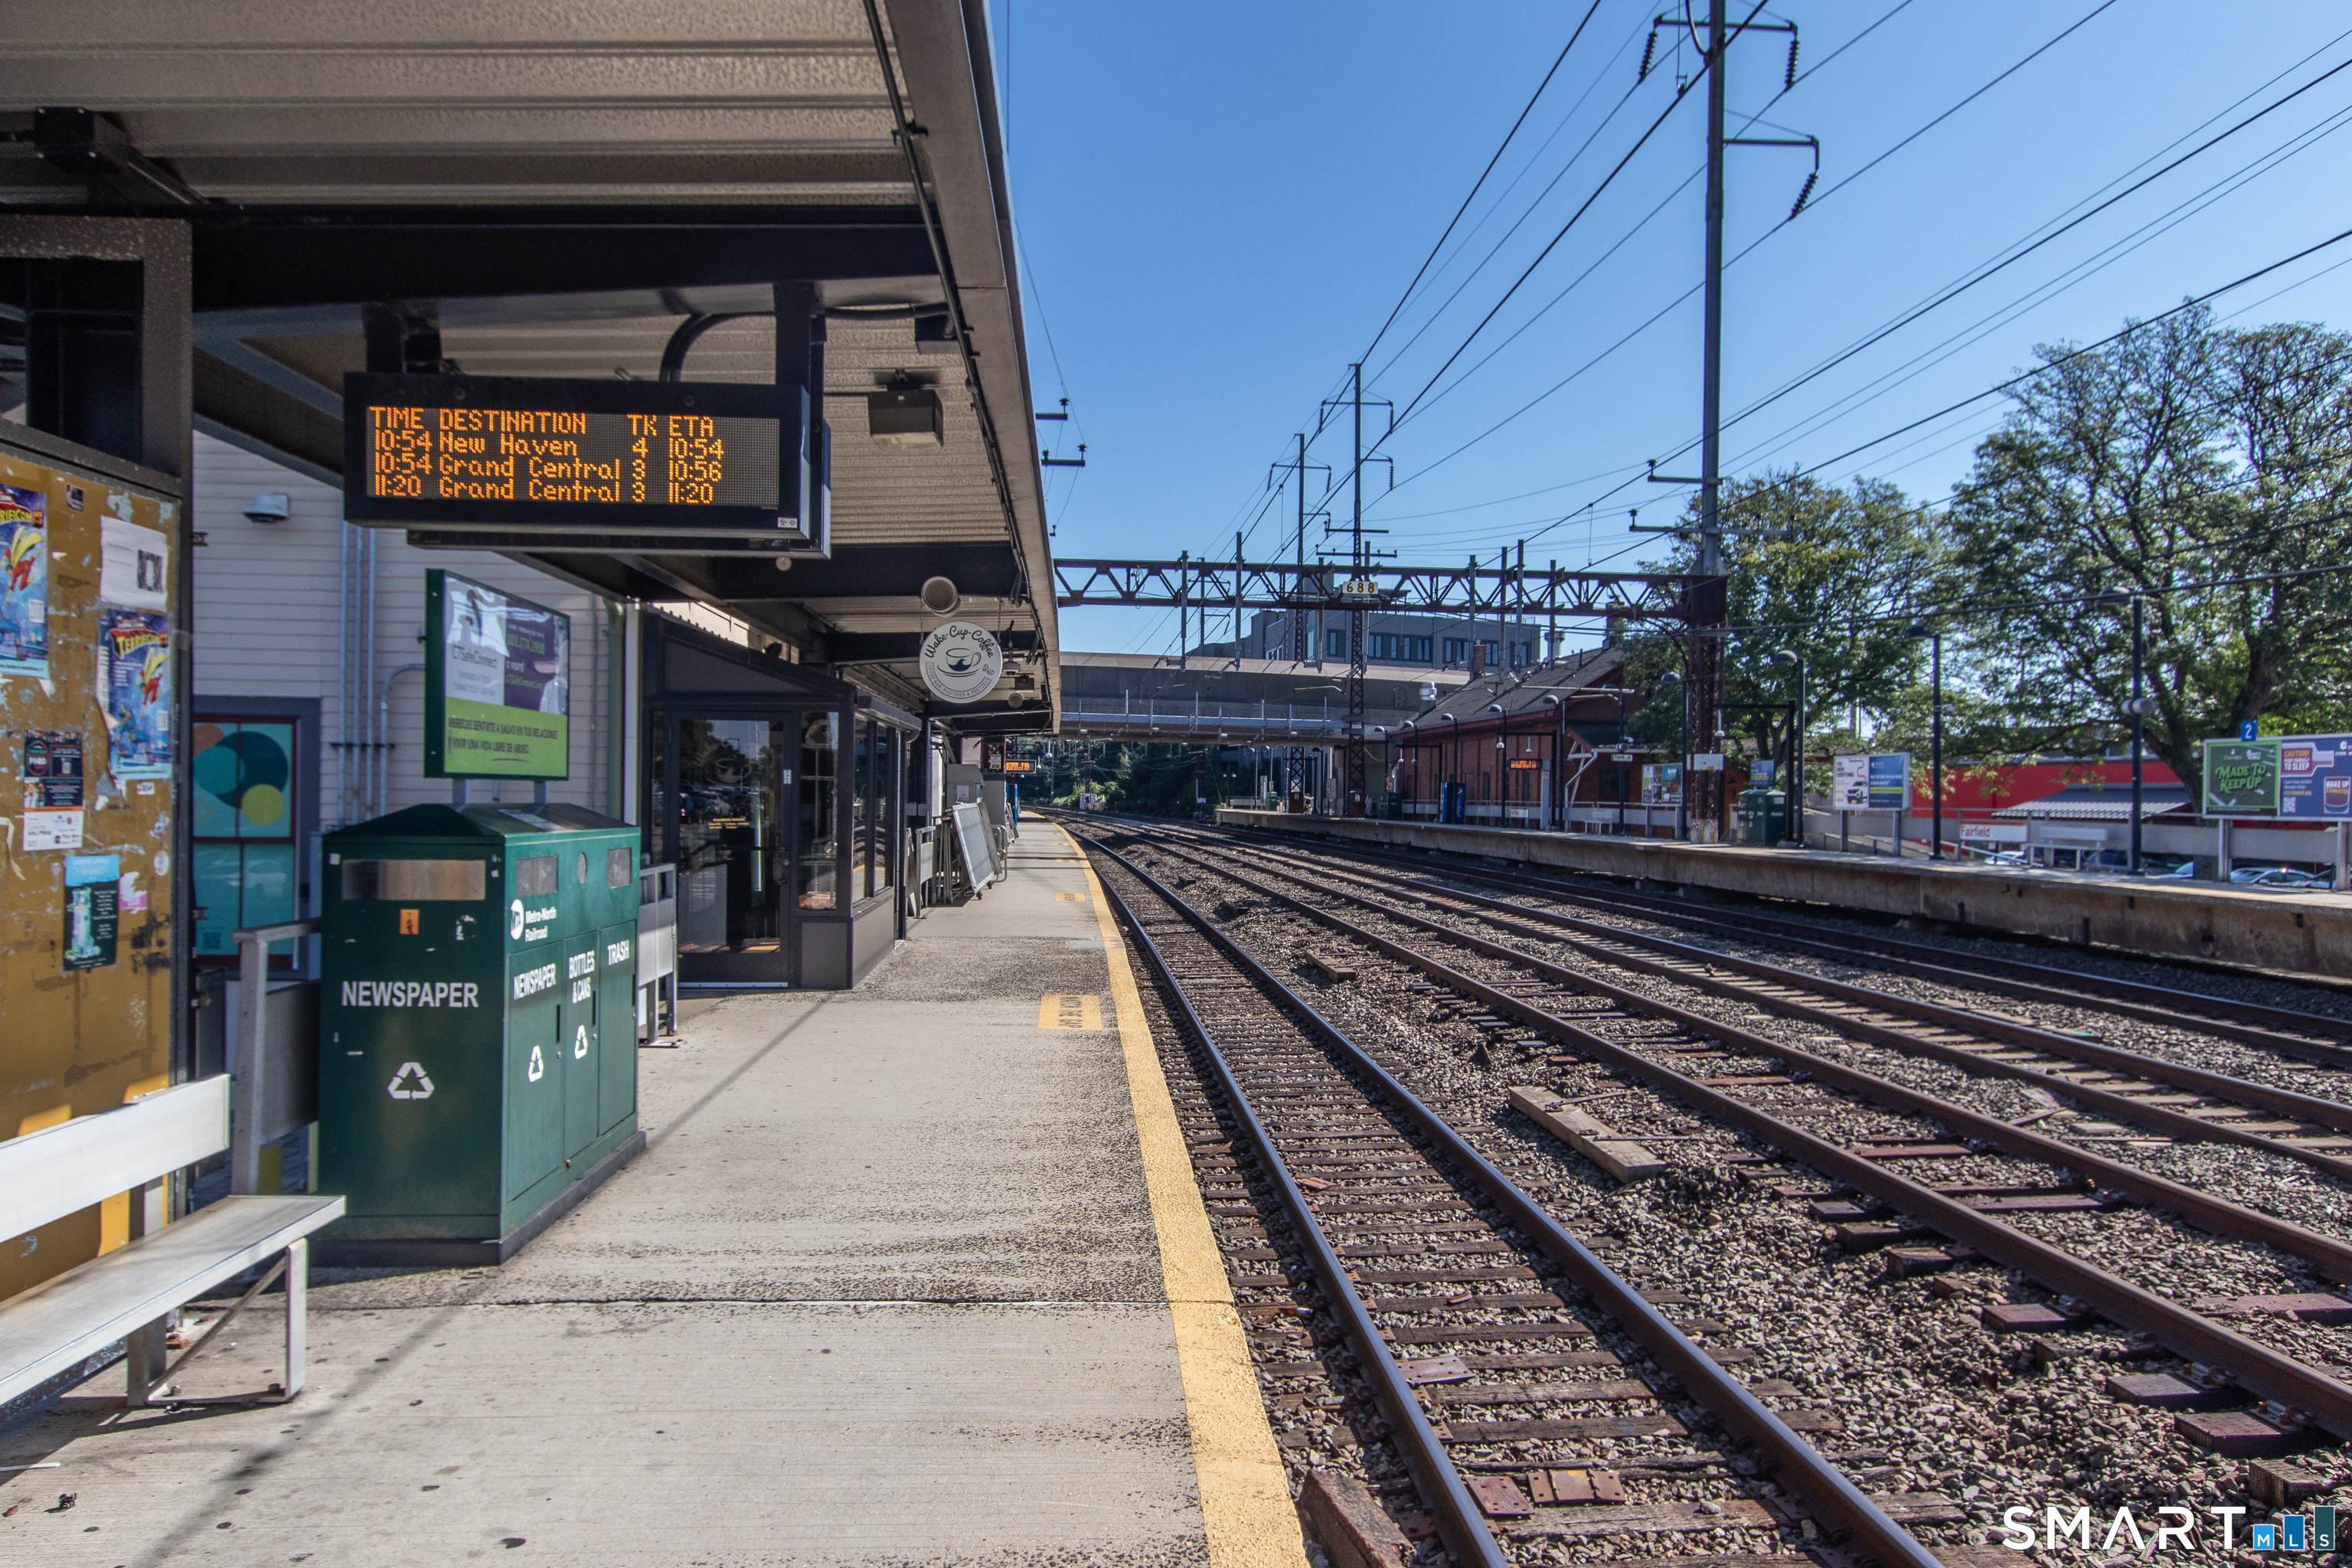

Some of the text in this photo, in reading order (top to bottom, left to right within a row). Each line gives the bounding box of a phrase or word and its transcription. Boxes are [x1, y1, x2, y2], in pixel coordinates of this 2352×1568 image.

[370, 406, 714, 437] TIME DESTINATION TK ETA
[374, 430, 724, 459] 10:54 New Haven 4 10:54
[374, 452, 723, 482] 10:54 Grand Central 3 10:56
[374, 475, 714, 505] 11:20 Grand Central 3 11:20
[1347, 583, 1374, 593] 688
[943, 688, 966, 697] PASTRIES
[971, 678, 991, 695] PRETZELS
[2245, 724, 2252, 740] 2
[2215, 763, 2266, 779] MADE TO
[2285, 761, 2310, 771] TO SLEEP
[2220, 776, 2262, 794] KEEP UP
[2326, 780, 2350, 789] WAKE UP
[1962, 824, 1991, 838] Fairfield
[524, 906, 557, 924] Metro-North
[524, 925, 548, 942] Railroad
[607, 939, 629, 965] TRASH
[568, 950, 595, 979] BOTTLES
[514, 963, 557, 1000] NEWSPAPER
[577, 979, 591, 1002] CANS
[341, 981, 479, 1008] NEWSPAPER
